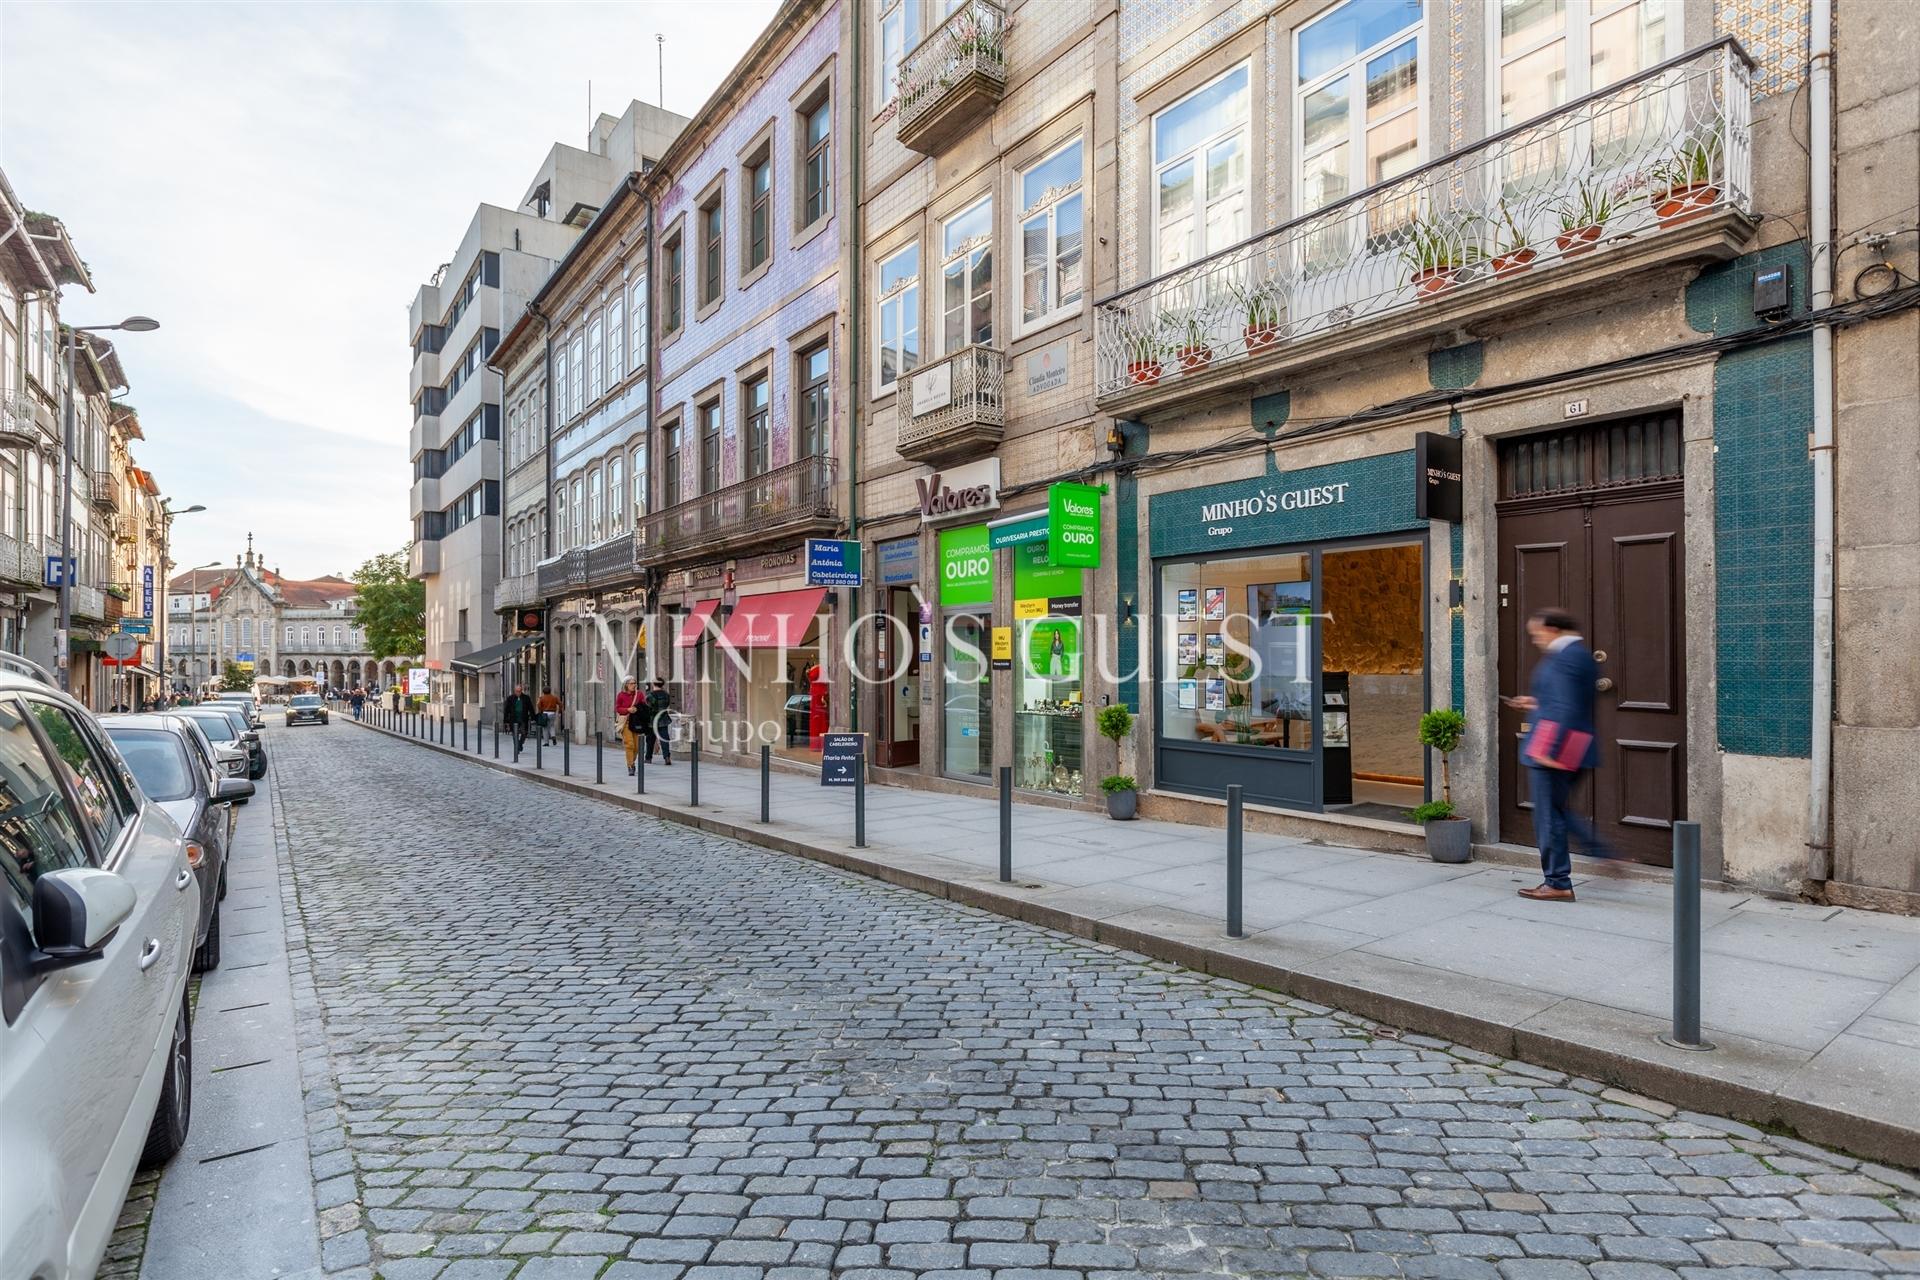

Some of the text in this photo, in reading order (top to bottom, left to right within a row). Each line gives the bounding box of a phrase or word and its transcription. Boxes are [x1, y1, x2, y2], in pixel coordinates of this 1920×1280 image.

[1569, 402, 1582, 414] 61
[1446, 472, 1461, 481] GUEST
[915, 473, 991, 516] Valores
[1281, 482, 1350, 511] GUEST
[1063, 498, 1094, 515] Valores
[1063, 524, 1095, 532] COMPRAMOS
[1208, 525, 1233, 536] Grupo
[995, 533, 1029, 544] OURIVESARIA
[1063, 532, 1095, 544] OURO
[814, 544, 839, 552] Maria
[946, 544, 990, 558] COMPRAMOS
[1027, 544, 1045, 553] OURO
[761, 554, 796, 568] PRONOVIAS
[811, 559, 843, 567] Antónia
[946, 557, 990, 579] OURO
[811, 571, 858, 579] Cabeleireiros
[144, 567, 153, 617] ALBERTO
